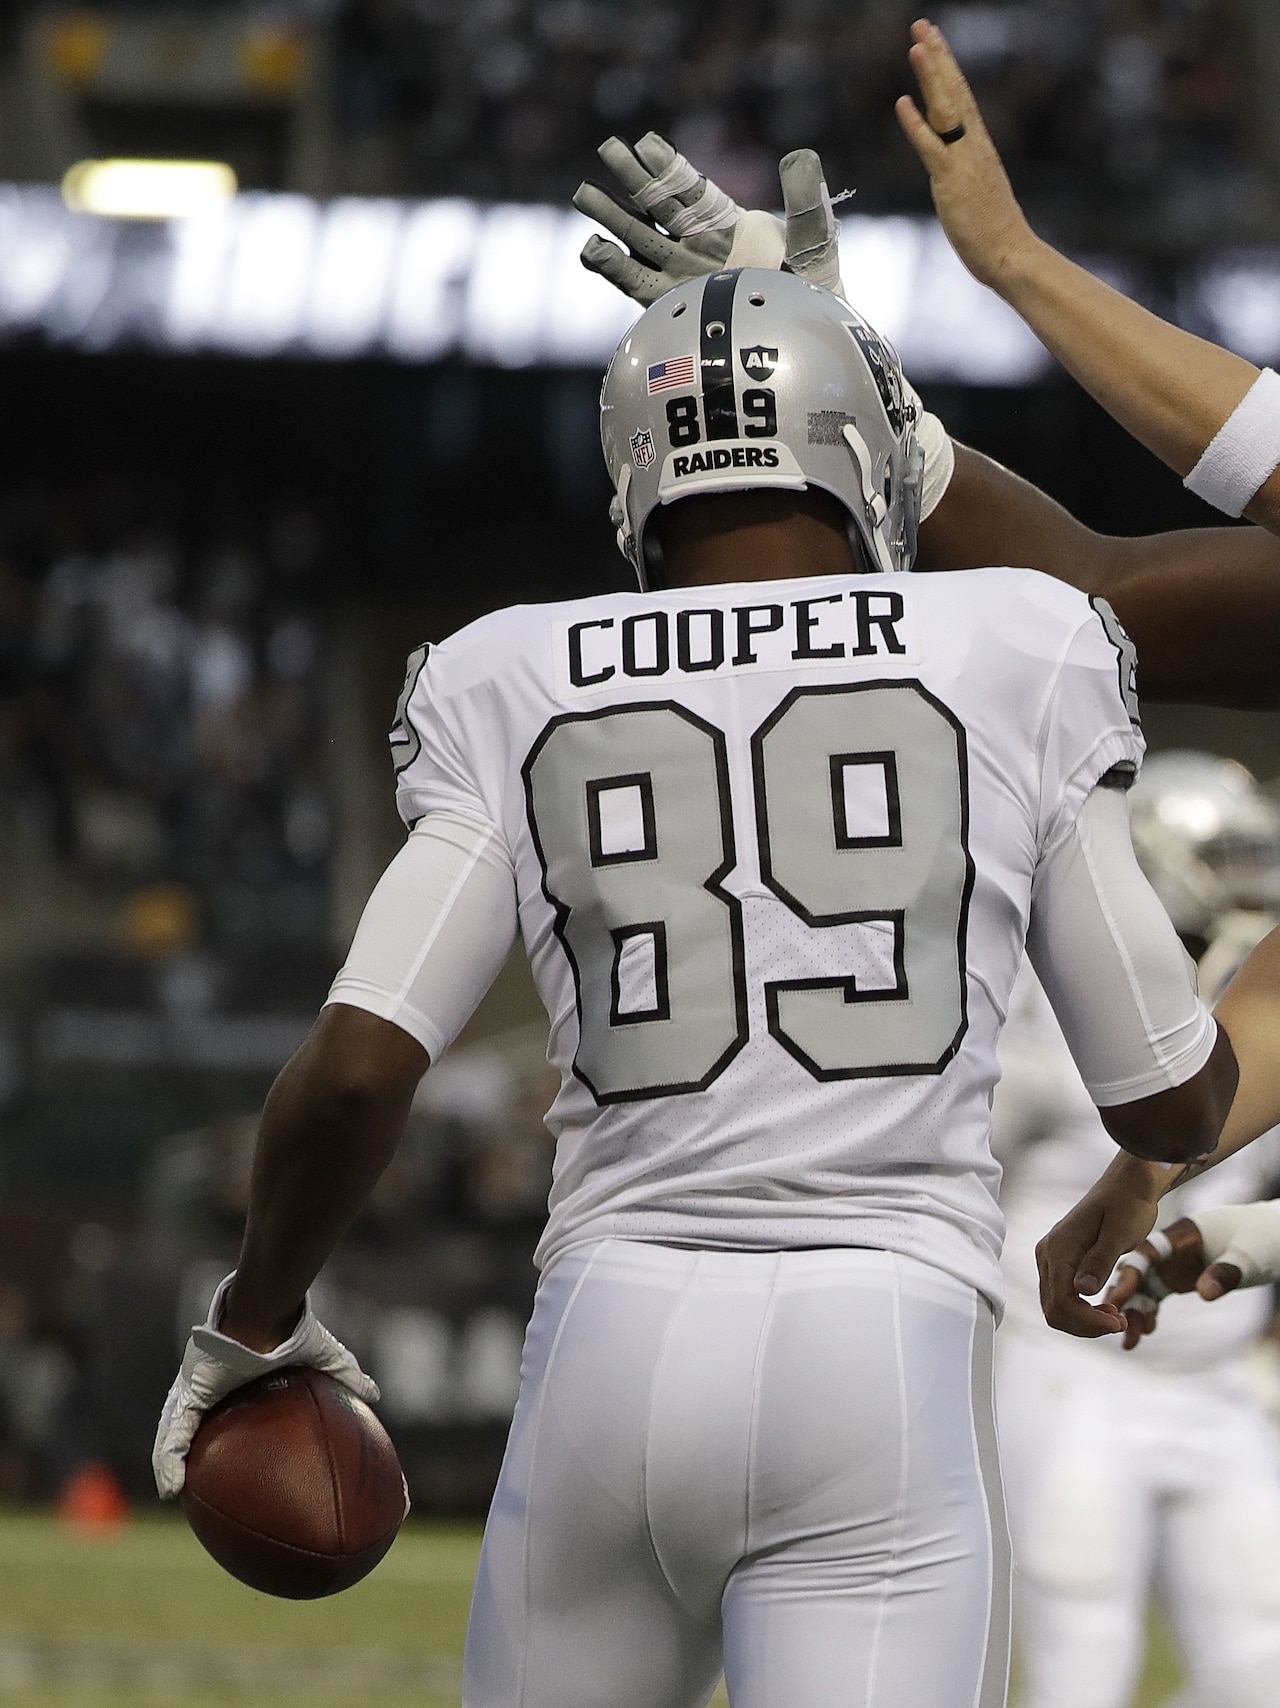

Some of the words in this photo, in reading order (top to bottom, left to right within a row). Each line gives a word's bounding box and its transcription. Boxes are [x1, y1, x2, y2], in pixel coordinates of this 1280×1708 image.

[745, 351, 776, 369] AL
[673, 447, 779, 478] RAIDERS
[568, 590, 907, 688] COOPER
[520, 678, 976, 1107] 89
